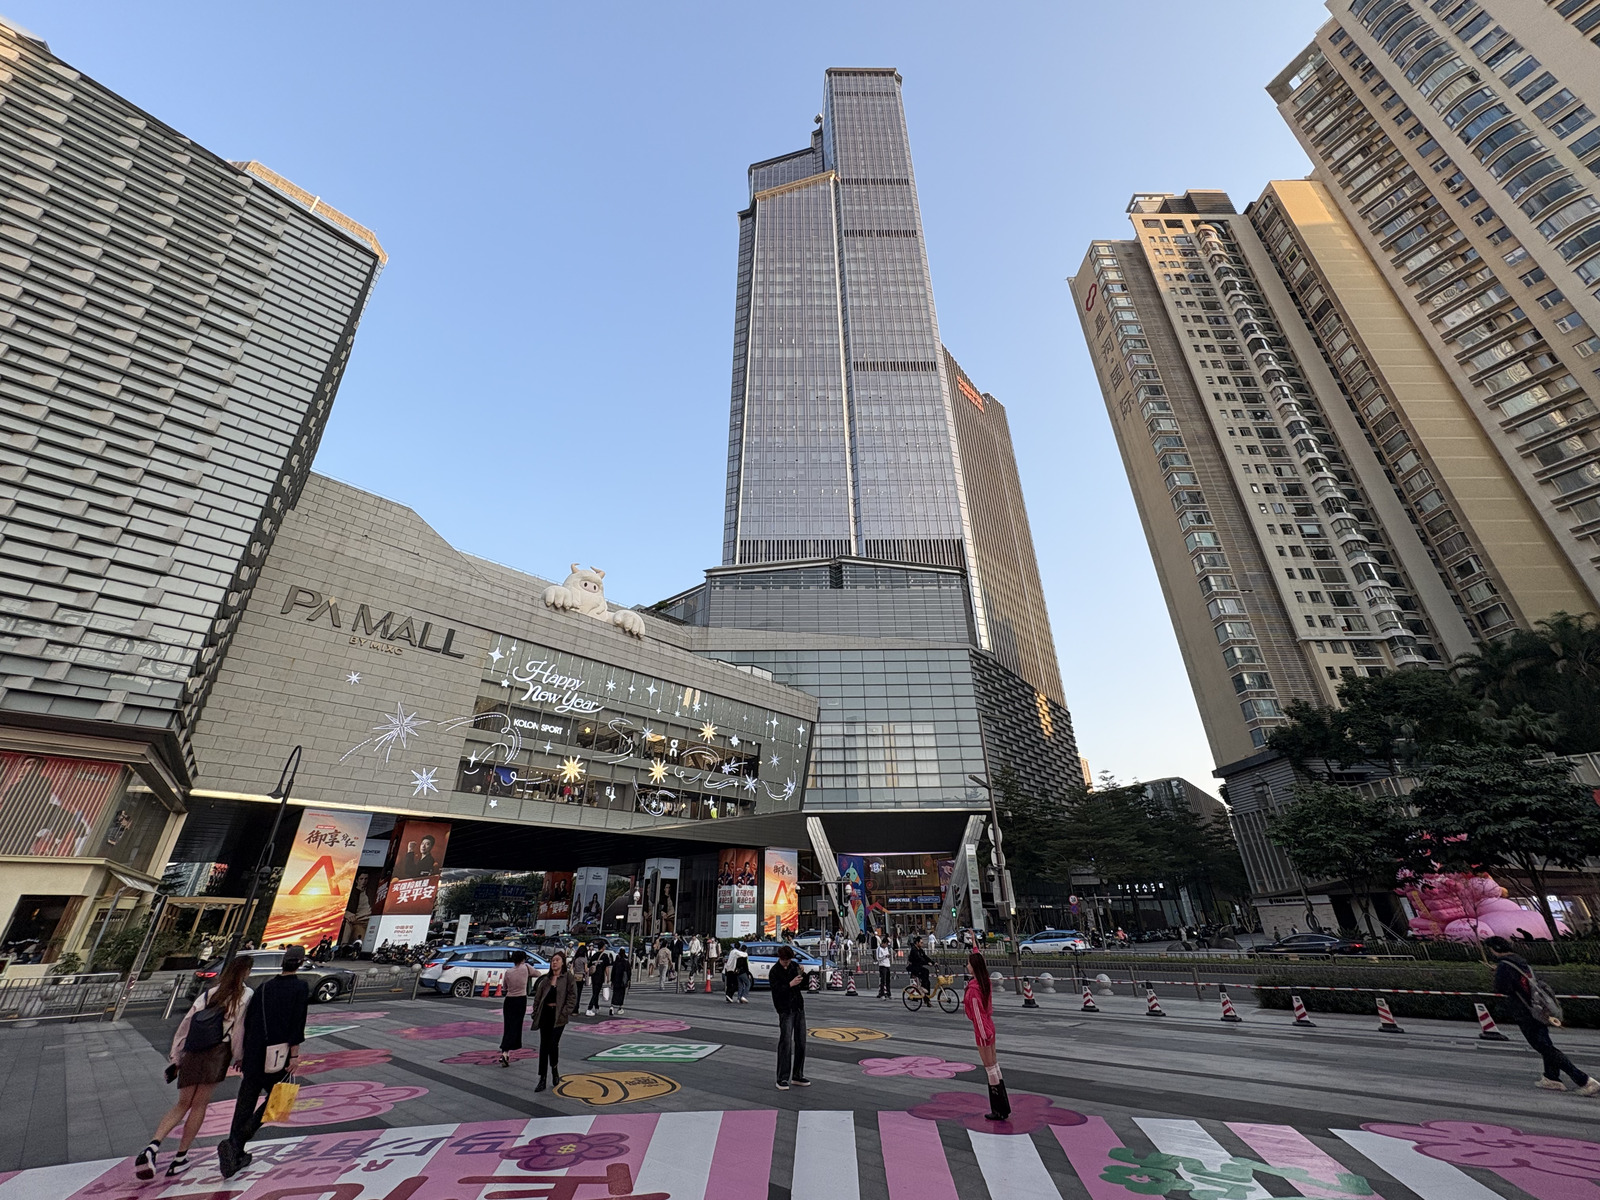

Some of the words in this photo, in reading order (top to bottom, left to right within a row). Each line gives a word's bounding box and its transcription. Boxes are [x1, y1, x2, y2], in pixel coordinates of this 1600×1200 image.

[280, 584, 342, 629] PA
[351, 603, 465, 660] MALL
[349, 636, 368, 648] BY
[369, 640, 404, 657] MIXC
[512, 660, 585, 691] Happy
[521, 681, 563, 703] New
[554, 690, 605, 714] Year
[513, 718, 539, 731] KOLON
[540, 723, 563, 735] SPORT
[907, 868, 928, 876] MALL
[395, 885, 436, 905] 买平安
